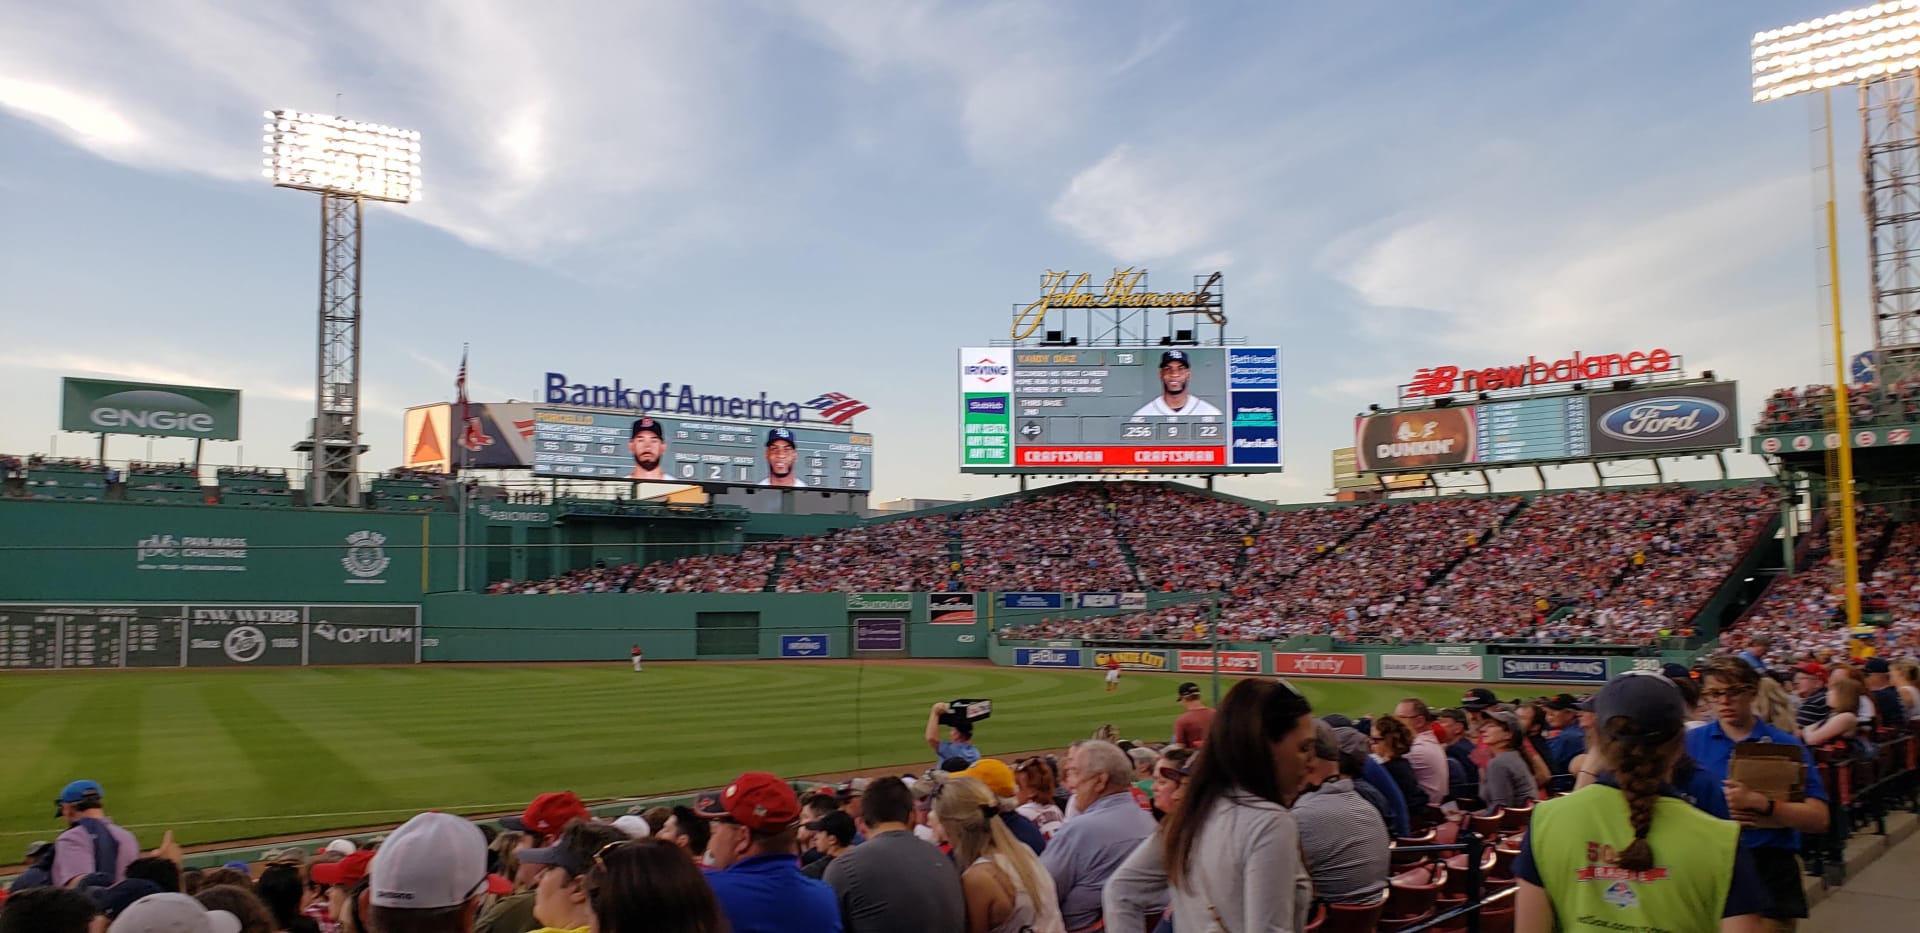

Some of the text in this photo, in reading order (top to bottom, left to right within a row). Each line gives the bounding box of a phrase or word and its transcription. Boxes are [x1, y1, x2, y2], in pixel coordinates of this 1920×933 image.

[1010, 266, 1227, 341] John Hancock
[1117, 353, 1134, 364] TB
[964, 365, 1009, 376] IRVING
[545, 372, 801, 422] Bank of America
[1623, 405, 1701, 434] Ford
[1167, 426, 1178, 437] 9
[1199, 426, 1218, 437] 22
[1024, 450, 1215, 462] CRAFTSMAN CRAFTSMAN
[1376, 439, 1455, 459] DUNKIN'
[682, 464, 695, 478] 0
[709, 465, 722, 479] 2
[337, 627, 412, 643] OPTUM
[1029, 649, 1067, 664] jetBlue
[1293, 655, 1345, 674] xfinity
[1504, 659, 1605, 675] SAMUEL ADAMS
